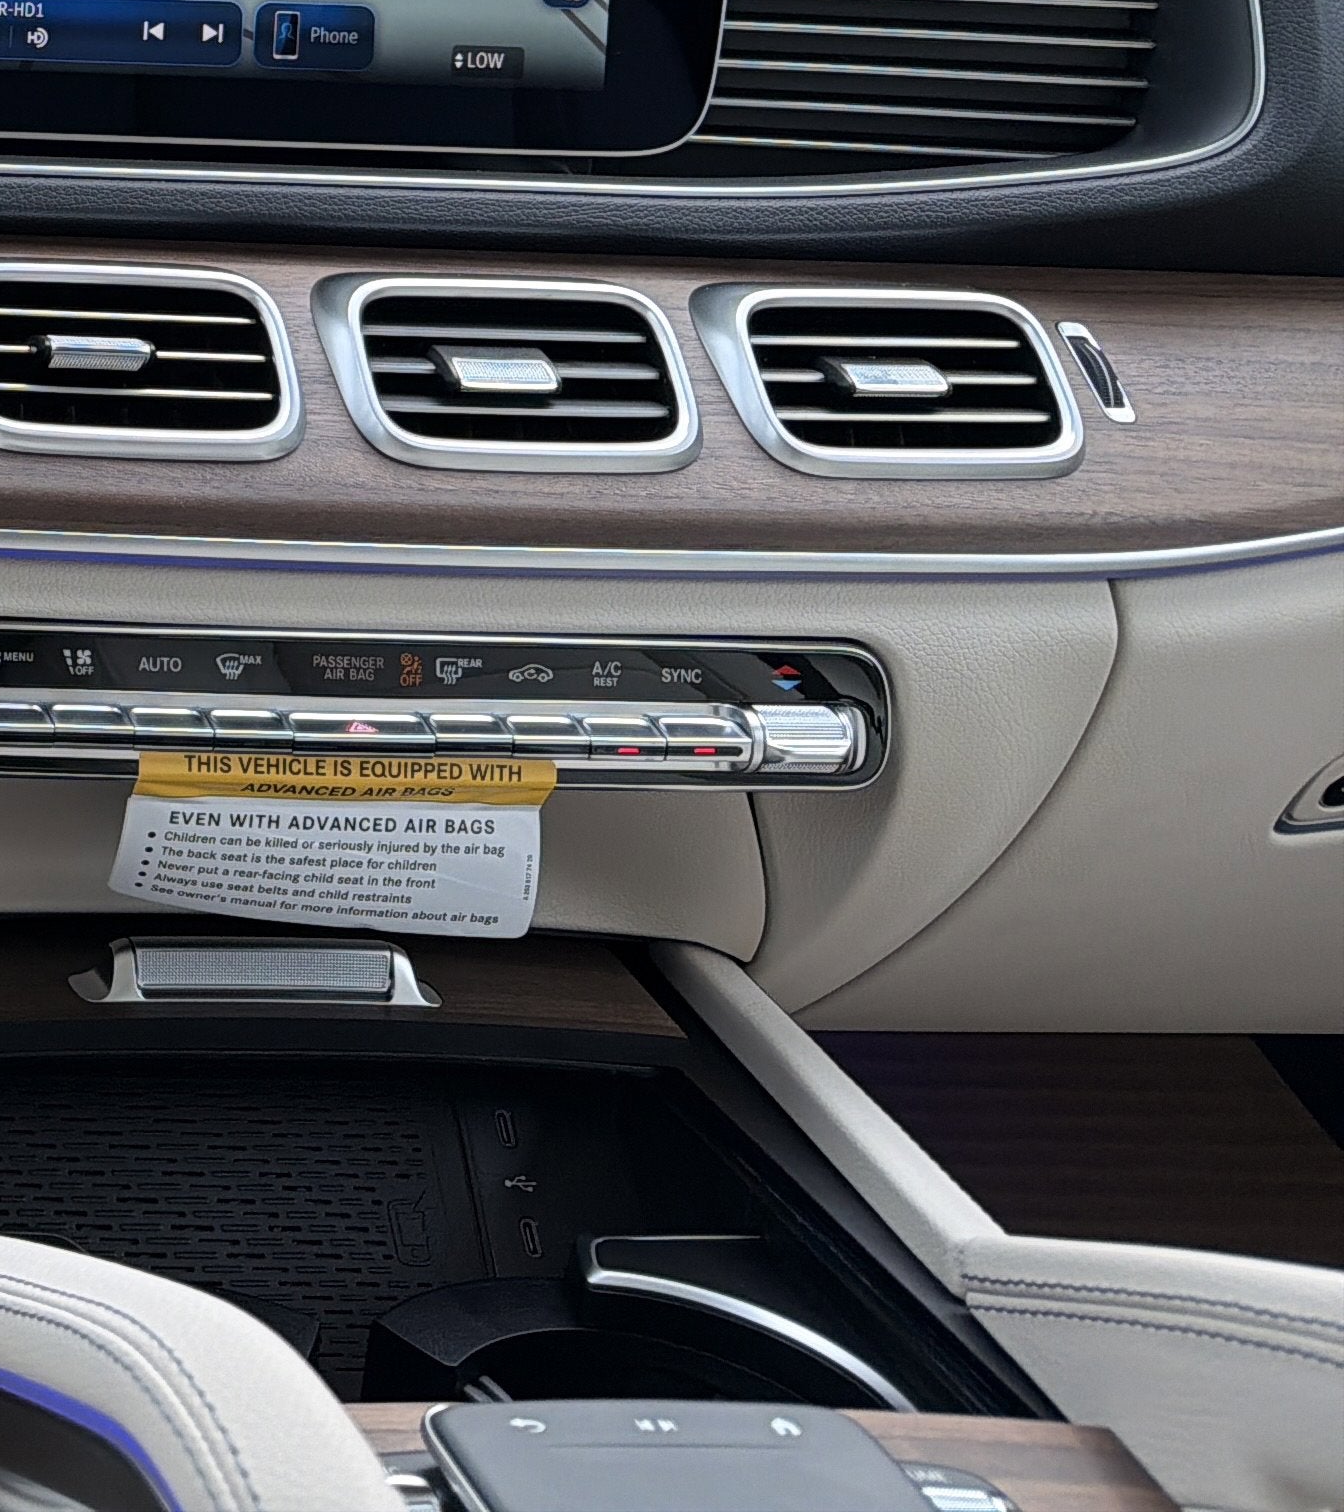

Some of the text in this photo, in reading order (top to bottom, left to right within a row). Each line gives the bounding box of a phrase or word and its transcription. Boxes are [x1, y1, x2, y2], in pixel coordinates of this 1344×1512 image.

[310, 27, 359, 46] Phone
[466, 52, 505, 70] LOW
[3, 651, 34, 662] MENU
[138, 656, 182, 673] AUTO
[239, 654, 262, 665] MAX
[313, 653, 385, 670] PASSENGER
[457, 657, 483, 669] REAR
[75, 666, 94, 676] OFF
[323, 668, 375, 682] AIR BAG
[591, 660, 622, 676] A/C
[661, 668, 703, 685] SYNC
[399, 674, 423, 687] OFF
[593, 676, 618, 688] REST
[184, 754, 522, 783] THIS VEHICLE IS EQUIPPED WITH
[240, 783, 455, 797] ADVANCED AIR BAGS
[169, 811, 496, 835] EVEN WITH ADVANCED AIR BAGS
[164, 831, 505, 858] Children can be killed or seriously injured by the air bag
[161, 846, 437, 872] The back seat is the safest place for children
[157, 860, 436, 889] Never put a rear-facing child seat in the front
[153, 873, 412, 905] Always use seat belts and child restraints
[150, 884, 499, 926] See owner's manual for more information about air bags
